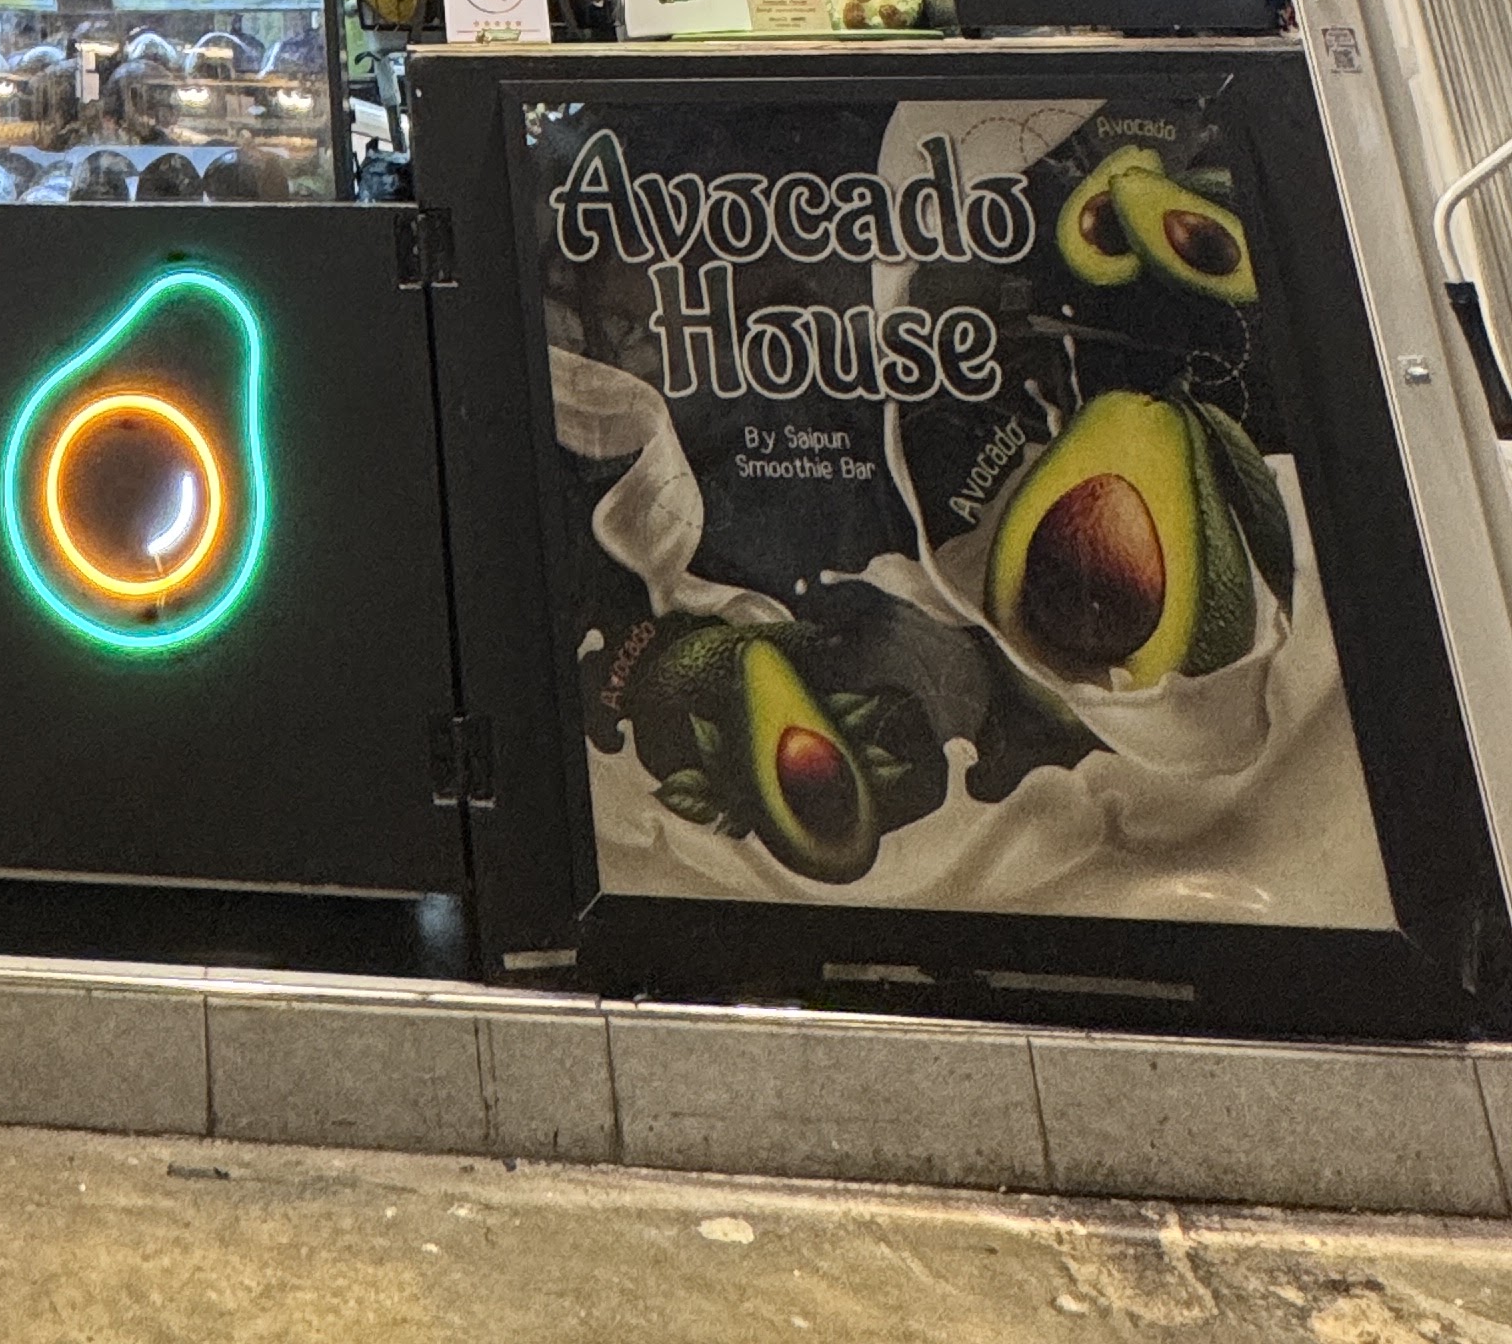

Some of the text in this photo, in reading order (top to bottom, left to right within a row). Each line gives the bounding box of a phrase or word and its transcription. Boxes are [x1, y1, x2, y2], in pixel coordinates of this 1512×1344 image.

[1097, 114, 1178, 142] Avocado
[549, 128, 1036, 264] Avocado
[648, 260, 1003, 400] House
[735, 453, 876, 481] Smoothie Bar
[744, 424, 851, 455] By Saipun
[948, 415, 1027, 524] Avocado
